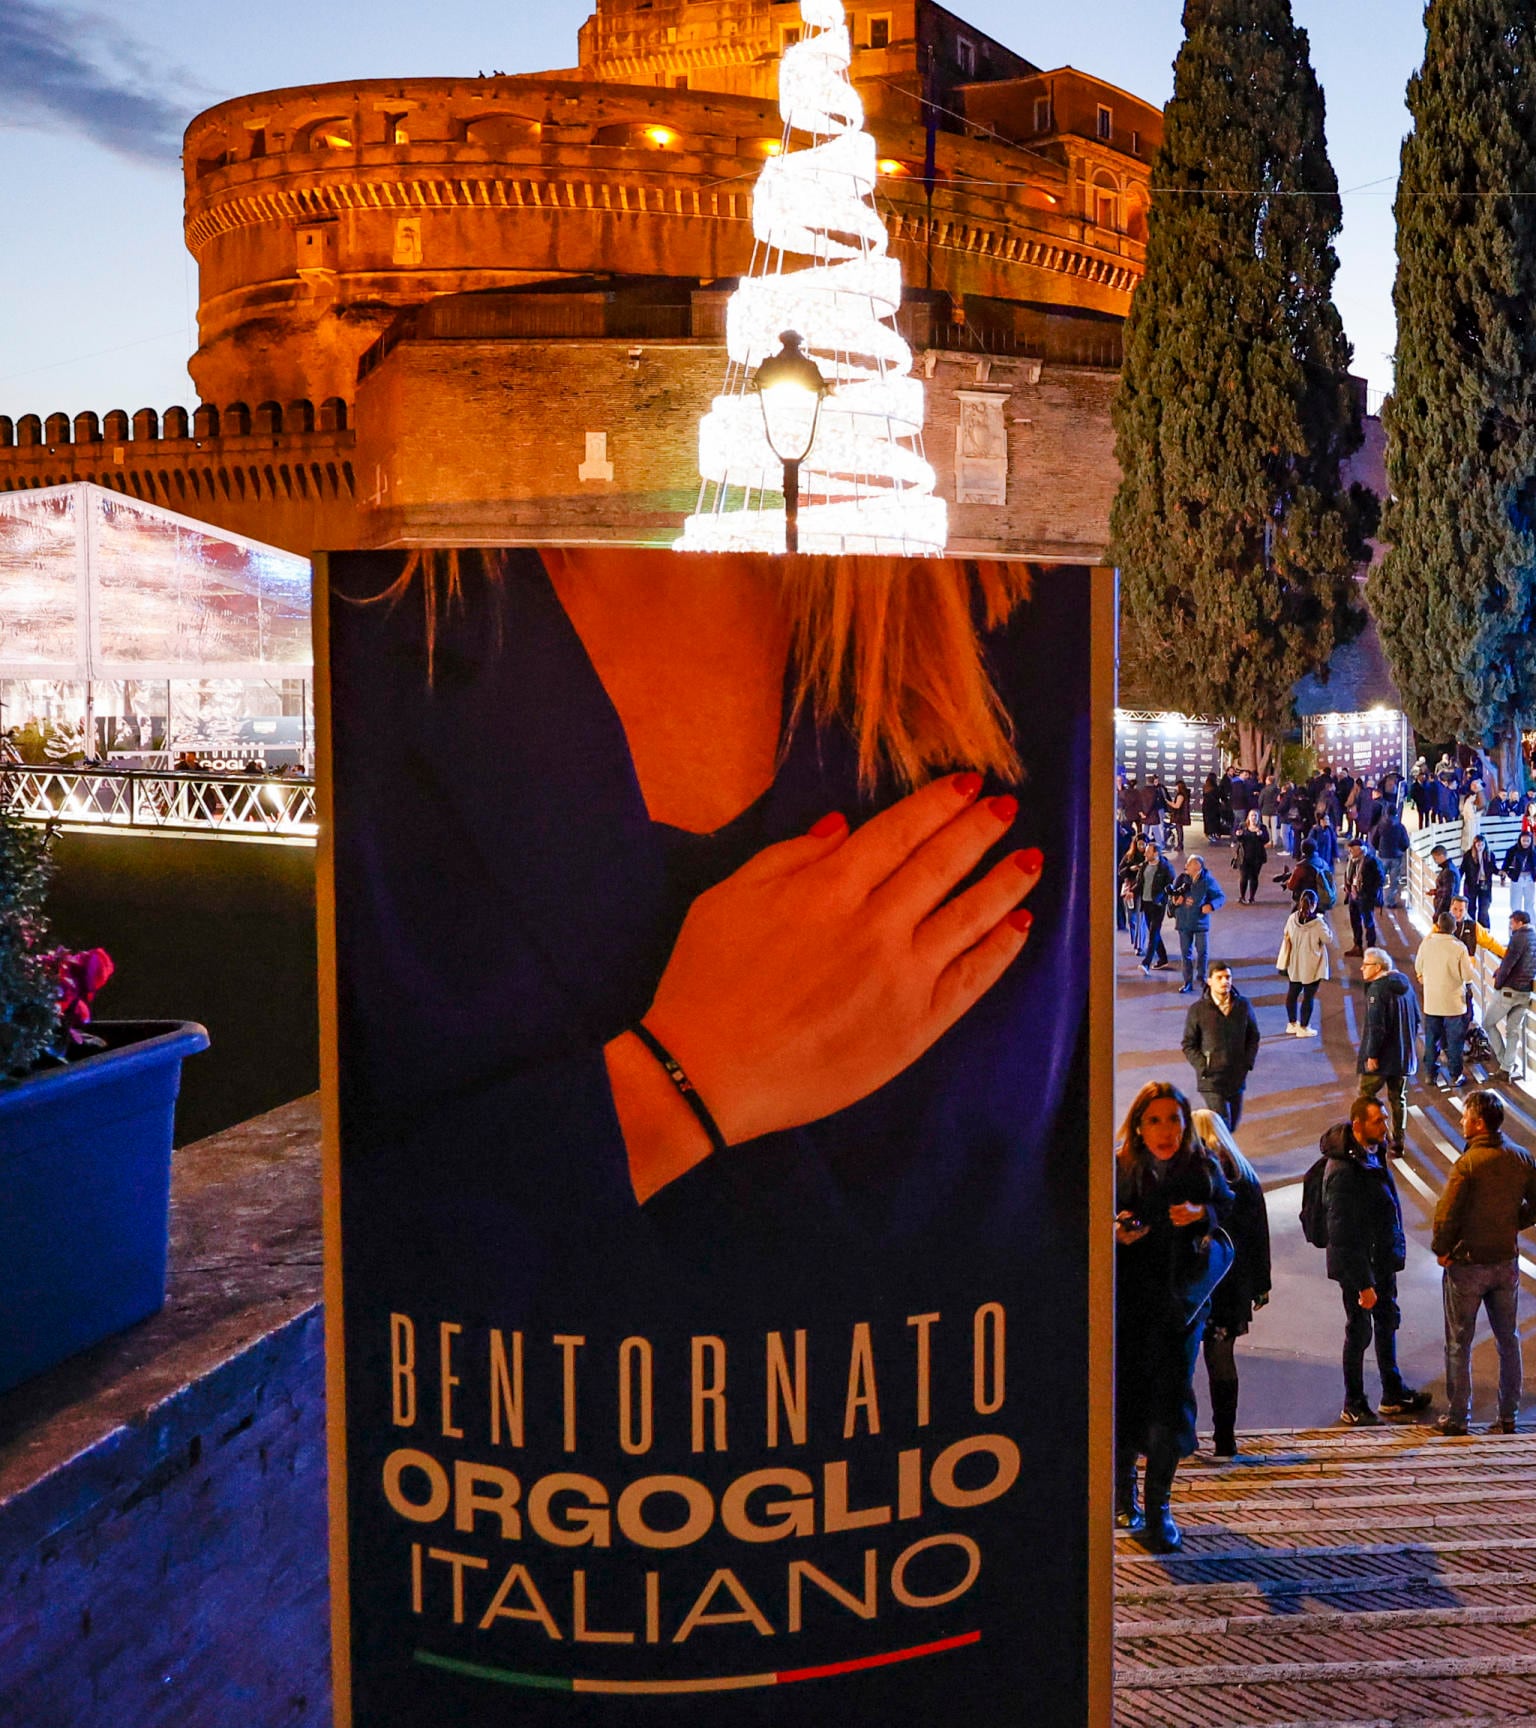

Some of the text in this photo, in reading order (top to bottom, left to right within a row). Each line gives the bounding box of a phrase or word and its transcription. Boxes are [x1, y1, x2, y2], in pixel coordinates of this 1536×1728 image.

[390, 1302, 1005, 1455] BENTORNATO
[382, 1434, 1021, 1549] ORGOGLIO
[411, 1533, 981, 1643] ITALIANO
